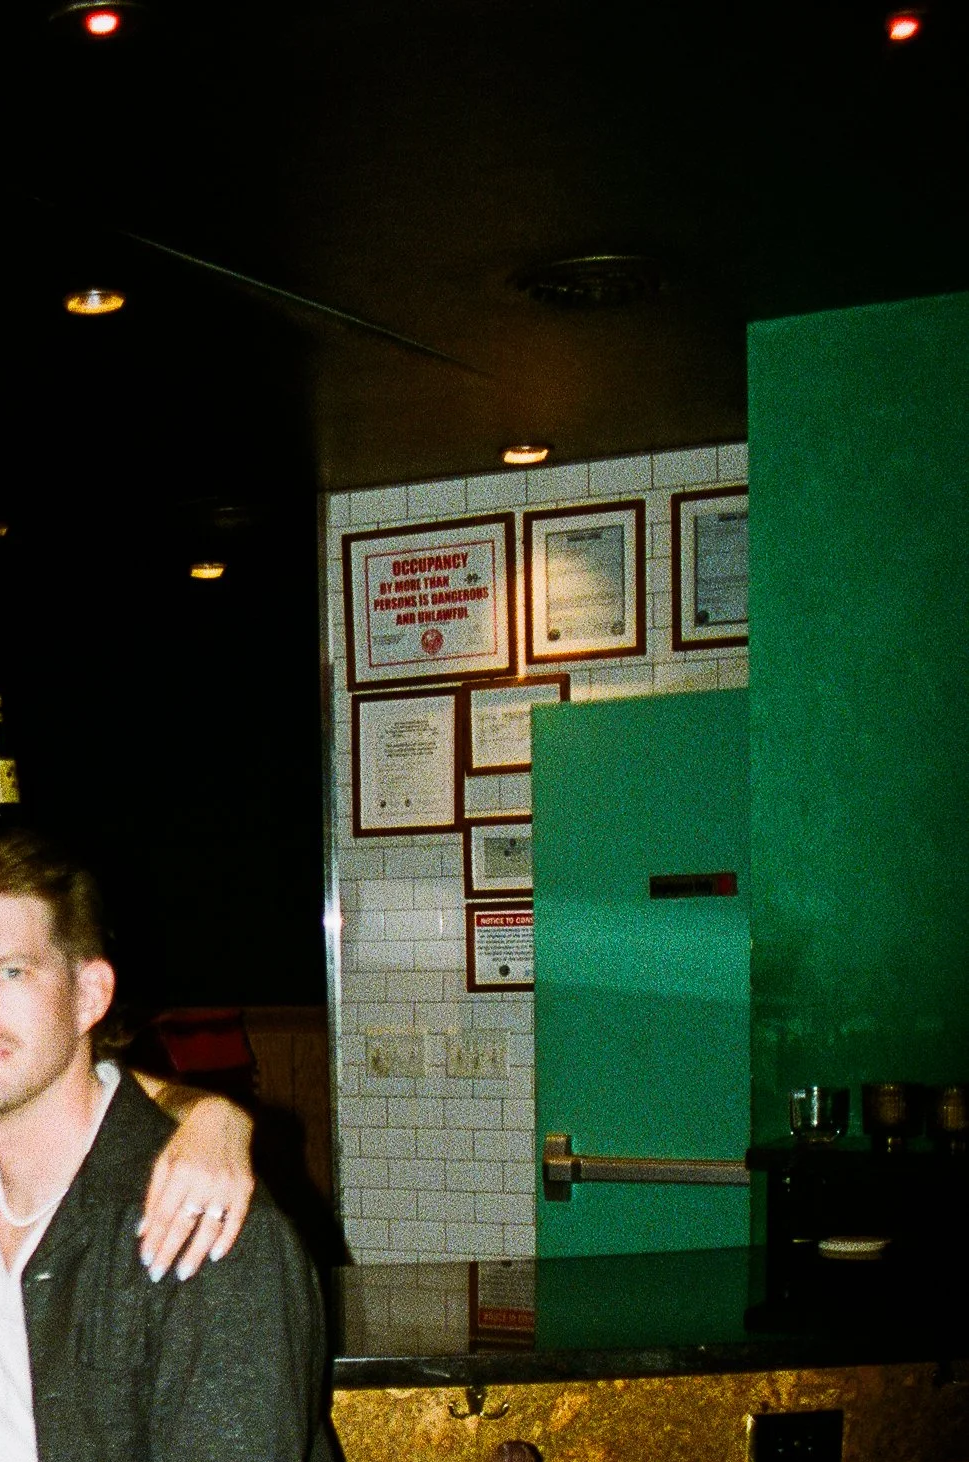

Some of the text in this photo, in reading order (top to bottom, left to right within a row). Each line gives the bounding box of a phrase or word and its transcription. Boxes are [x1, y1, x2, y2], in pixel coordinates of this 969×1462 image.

[392, 553, 468, 576] OCCUPANCY
[379, 582, 392, 595] BY
[394, 578, 421, 593] MORE
[423, 575, 449, 589] THAN
[373, 586, 489, 611] PERSONS IS DANGEROUS
[396, 612, 416, 625] AND
[417, 606, 469, 624] UNLAWFUL
[480, 917, 504, 925] NOTICE
